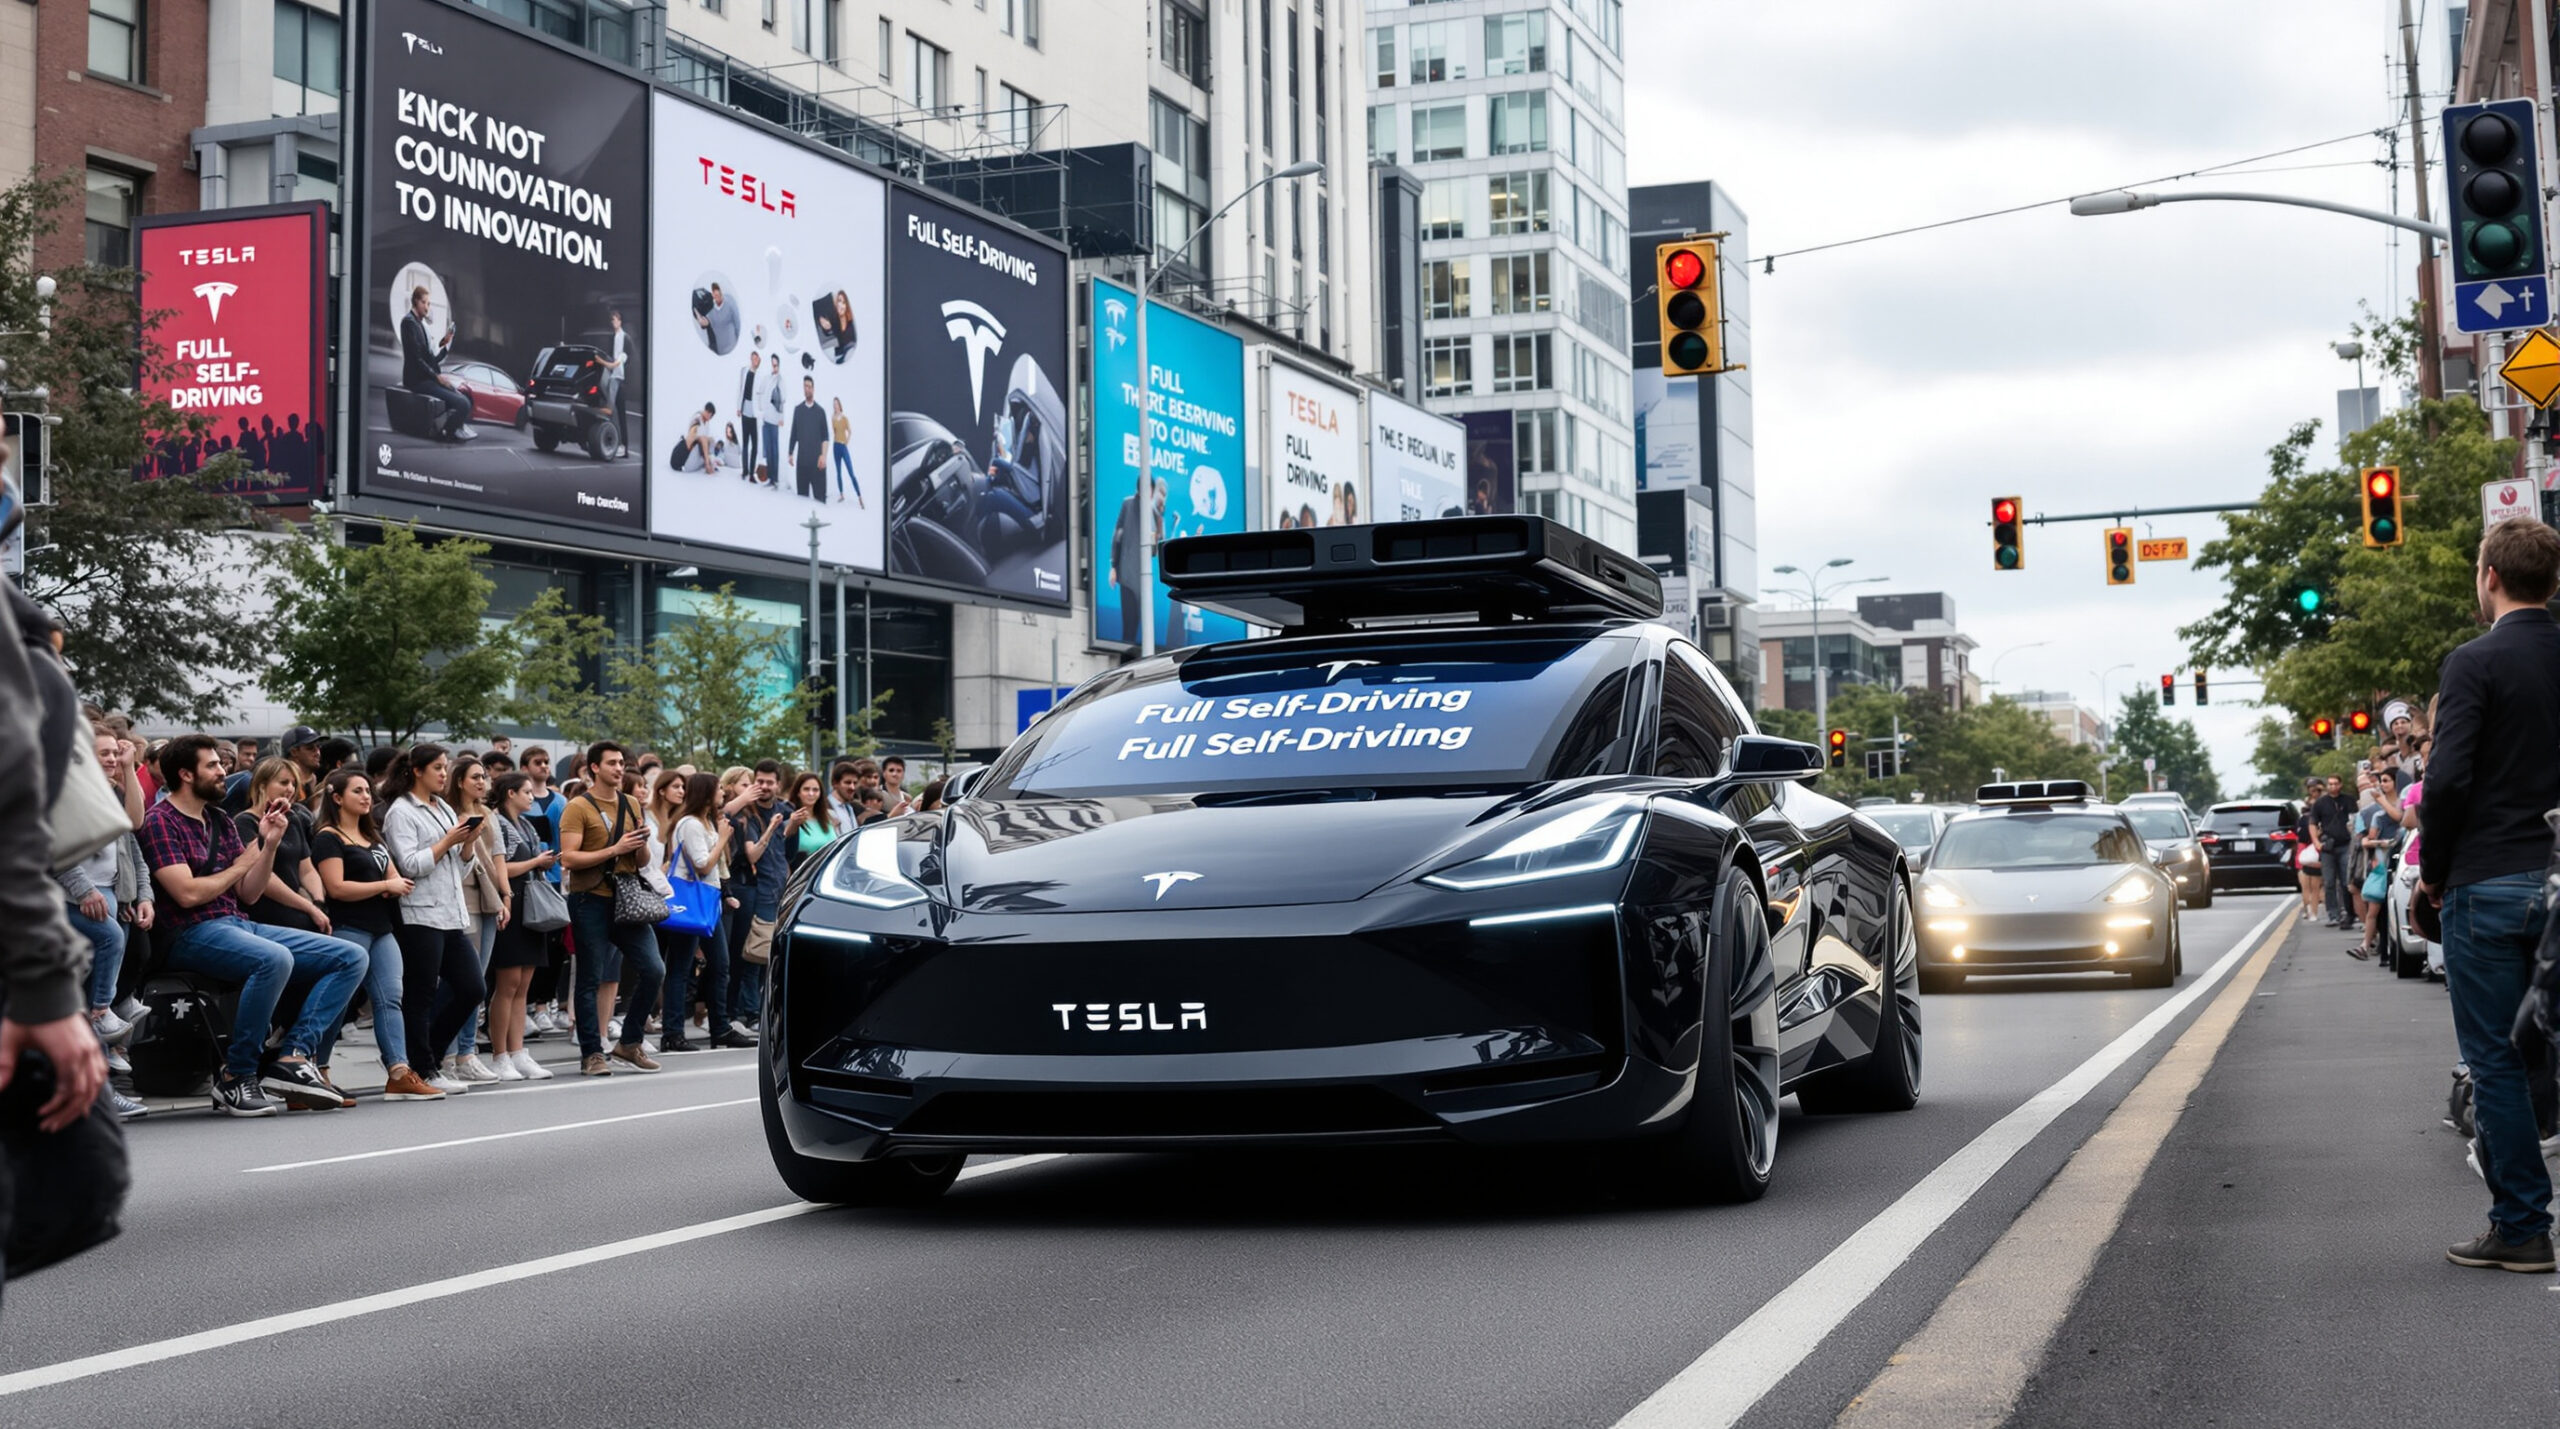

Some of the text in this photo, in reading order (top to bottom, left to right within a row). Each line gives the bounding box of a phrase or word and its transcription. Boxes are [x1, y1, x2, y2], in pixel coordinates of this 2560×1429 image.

[486, 116, 546, 165] NOT
[395, 135, 611, 228] COUNNOVATION
[699, 157, 796, 218] TESLA
[395, 181, 609, 271] TO INNOVATION.
[179, 247, 254, 265] TESLA
[176, 338, 231, 359] FULL
[196, 363, 259, 382] SELF-
[1151, 364, 1184, 394] FULL
[171, 386, 262, 408] DRIVING
[1287, 390, 1340, 436] TESLA
[1286, 434, 1312, 461] FULL
[1287, 463, 1328, 494] DRIVING
[1136, 687, 1472, 723] Full Self-Driving
[1118, 734, 1197, 760] Full
[1052, 1002, 1207, 1031] TESLA
